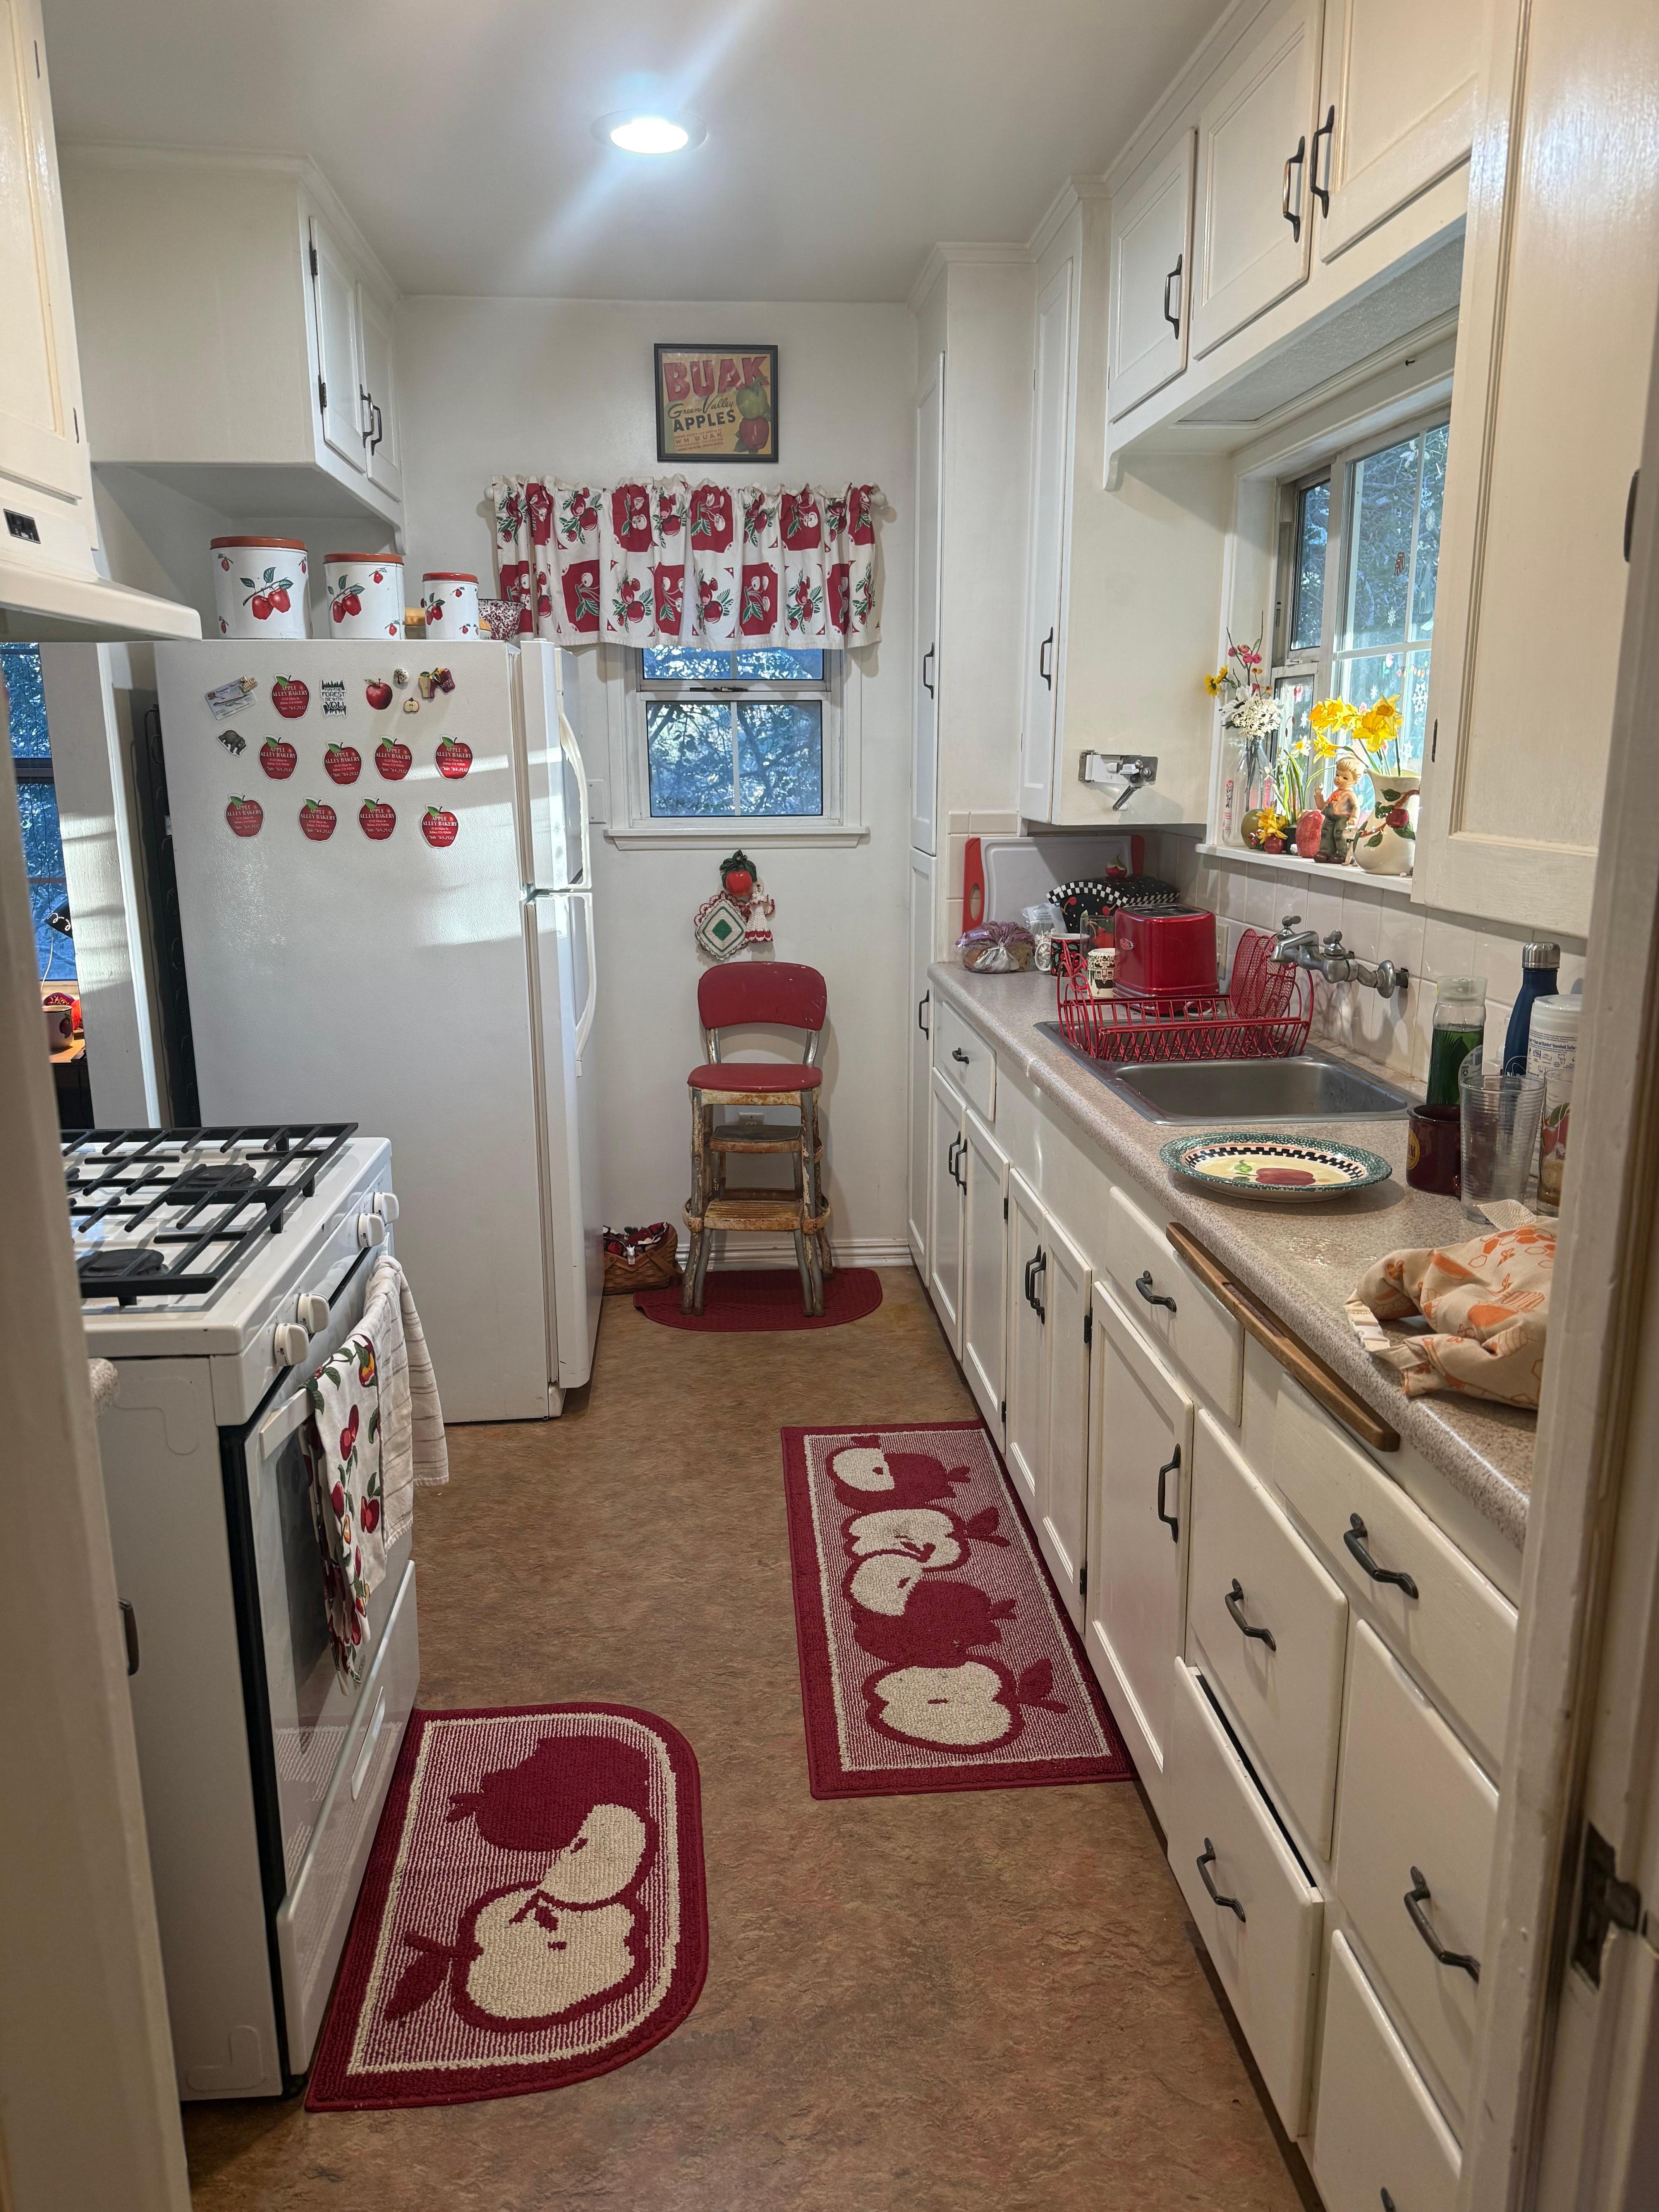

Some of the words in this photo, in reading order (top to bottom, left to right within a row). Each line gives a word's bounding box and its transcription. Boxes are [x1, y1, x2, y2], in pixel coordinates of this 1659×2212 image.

[663, 356, 770, 402] BUAK
[668, 404, 701, 419] Green
[702, 395, 734, 414] Valley
[673, 409, 736, 432] APPLES
[695, 431, 722, 441] BUAK
